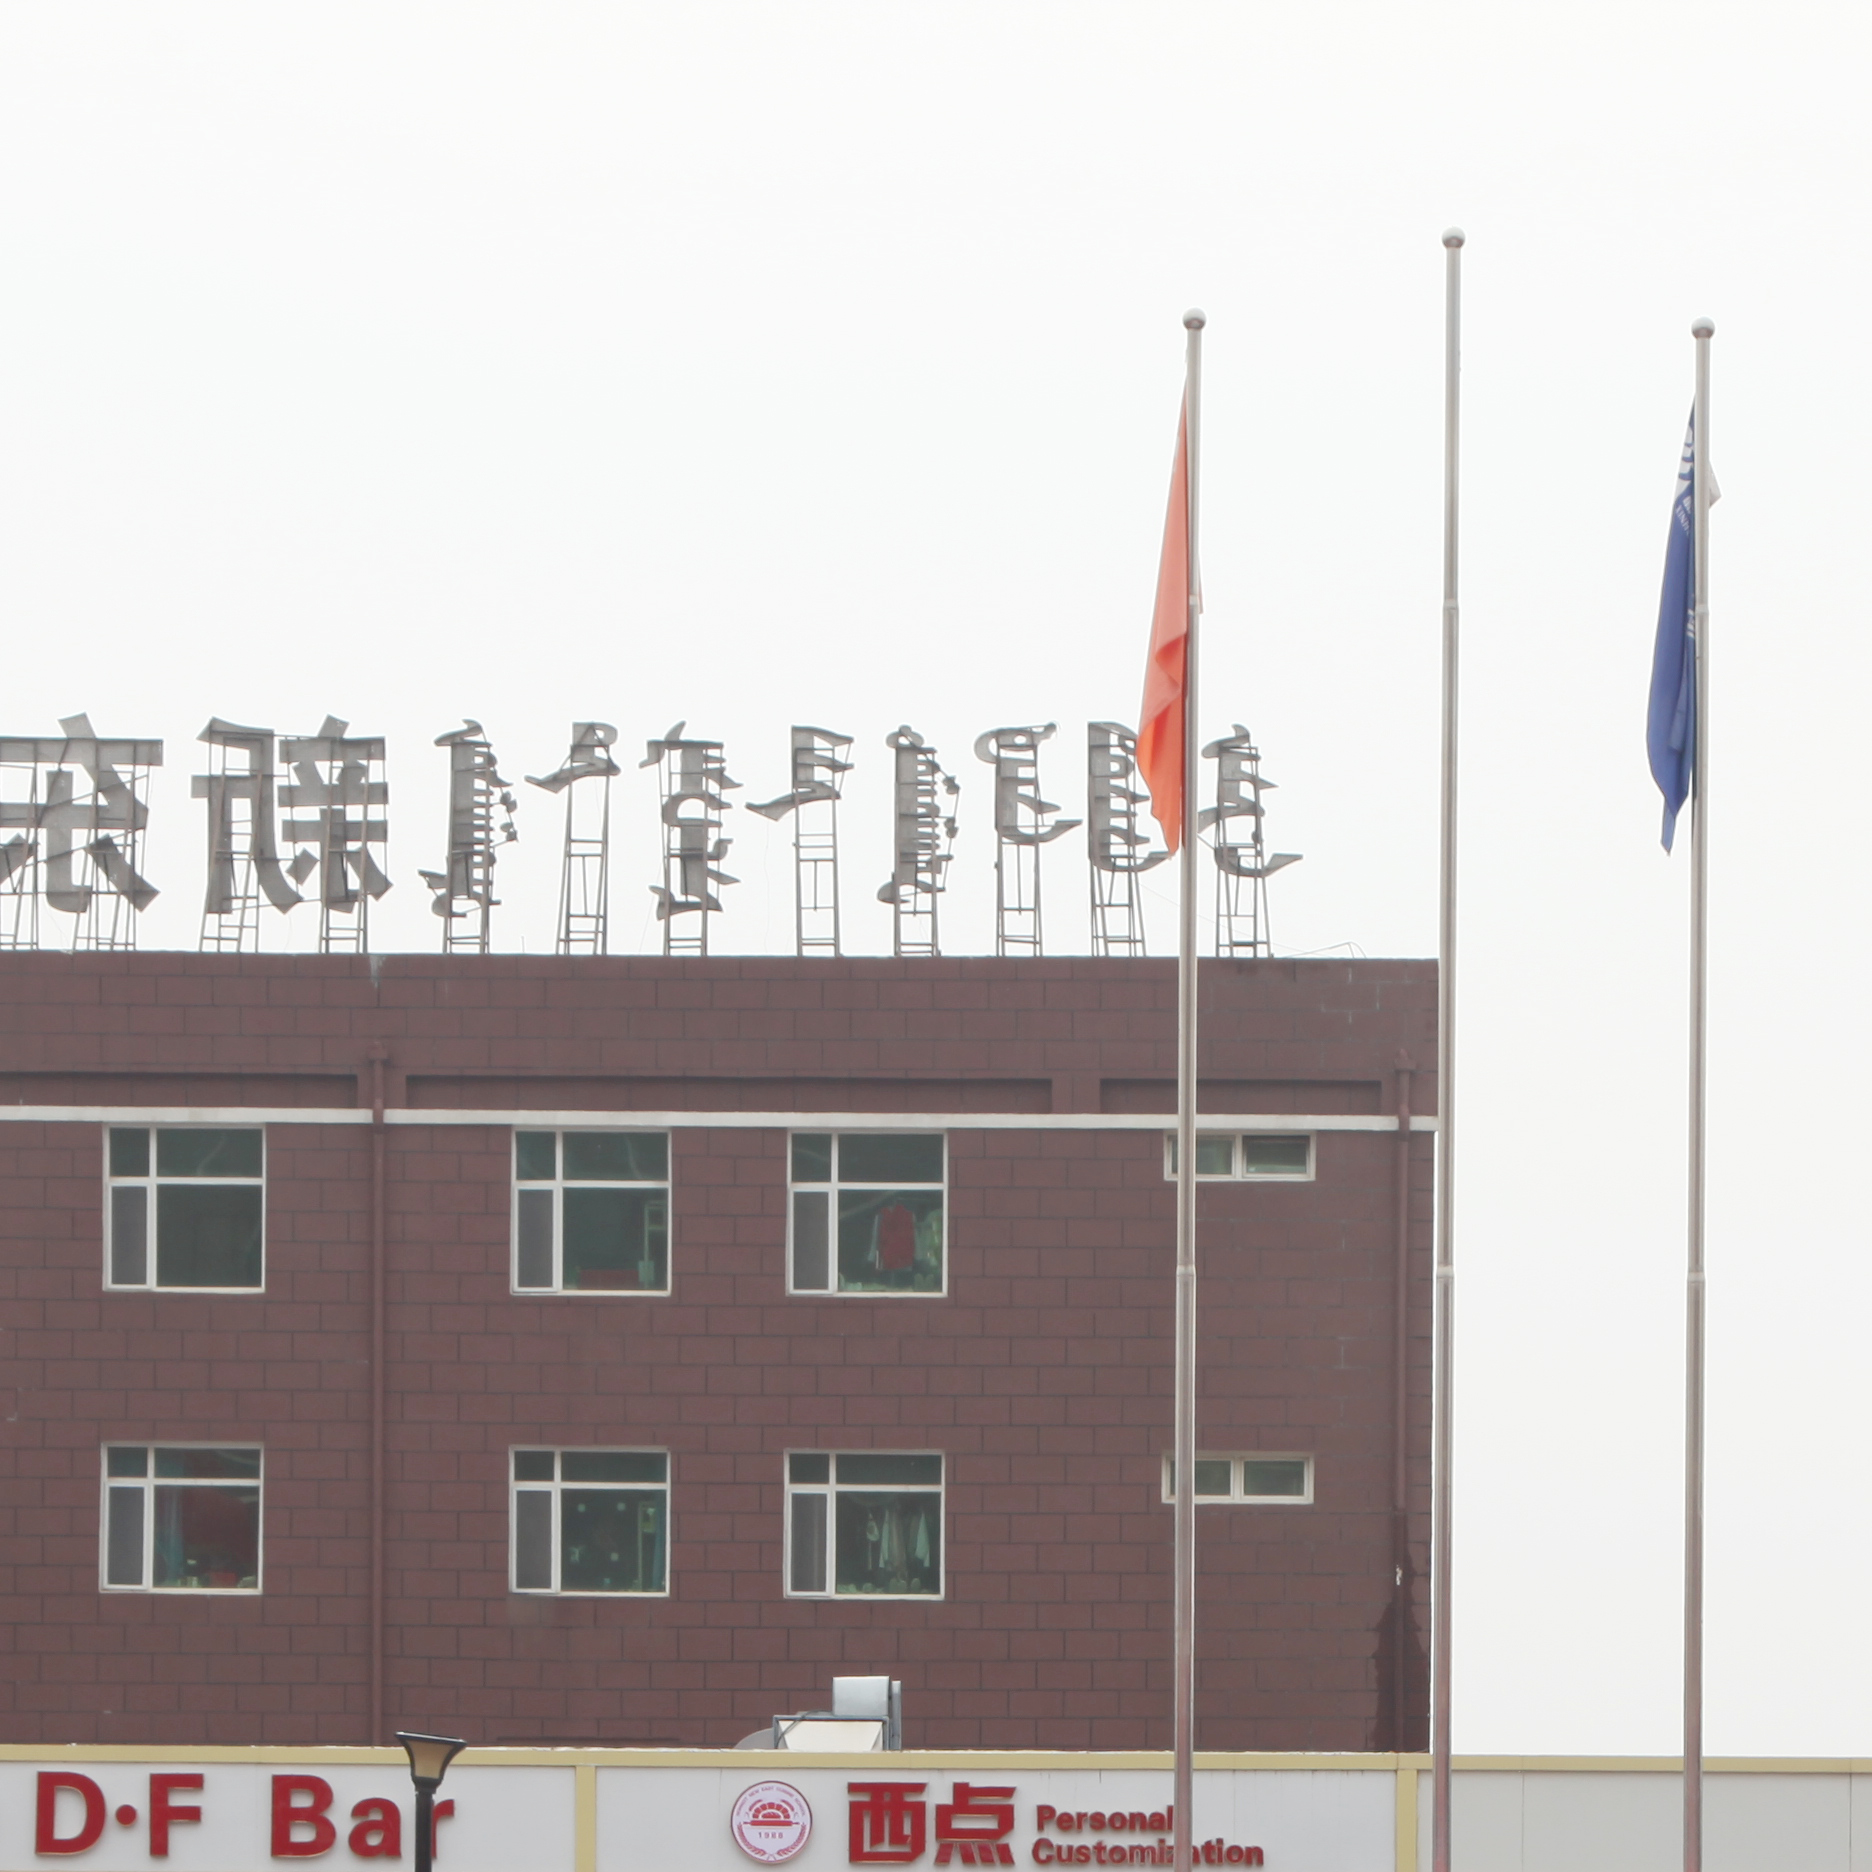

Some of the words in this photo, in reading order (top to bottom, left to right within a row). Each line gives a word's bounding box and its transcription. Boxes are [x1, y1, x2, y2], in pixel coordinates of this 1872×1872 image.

[271, 1774, 455, 1858] Bar
[847, 1781, 1017, 1867] 西点
[1036, 1804, 1174, 1831] Personal
